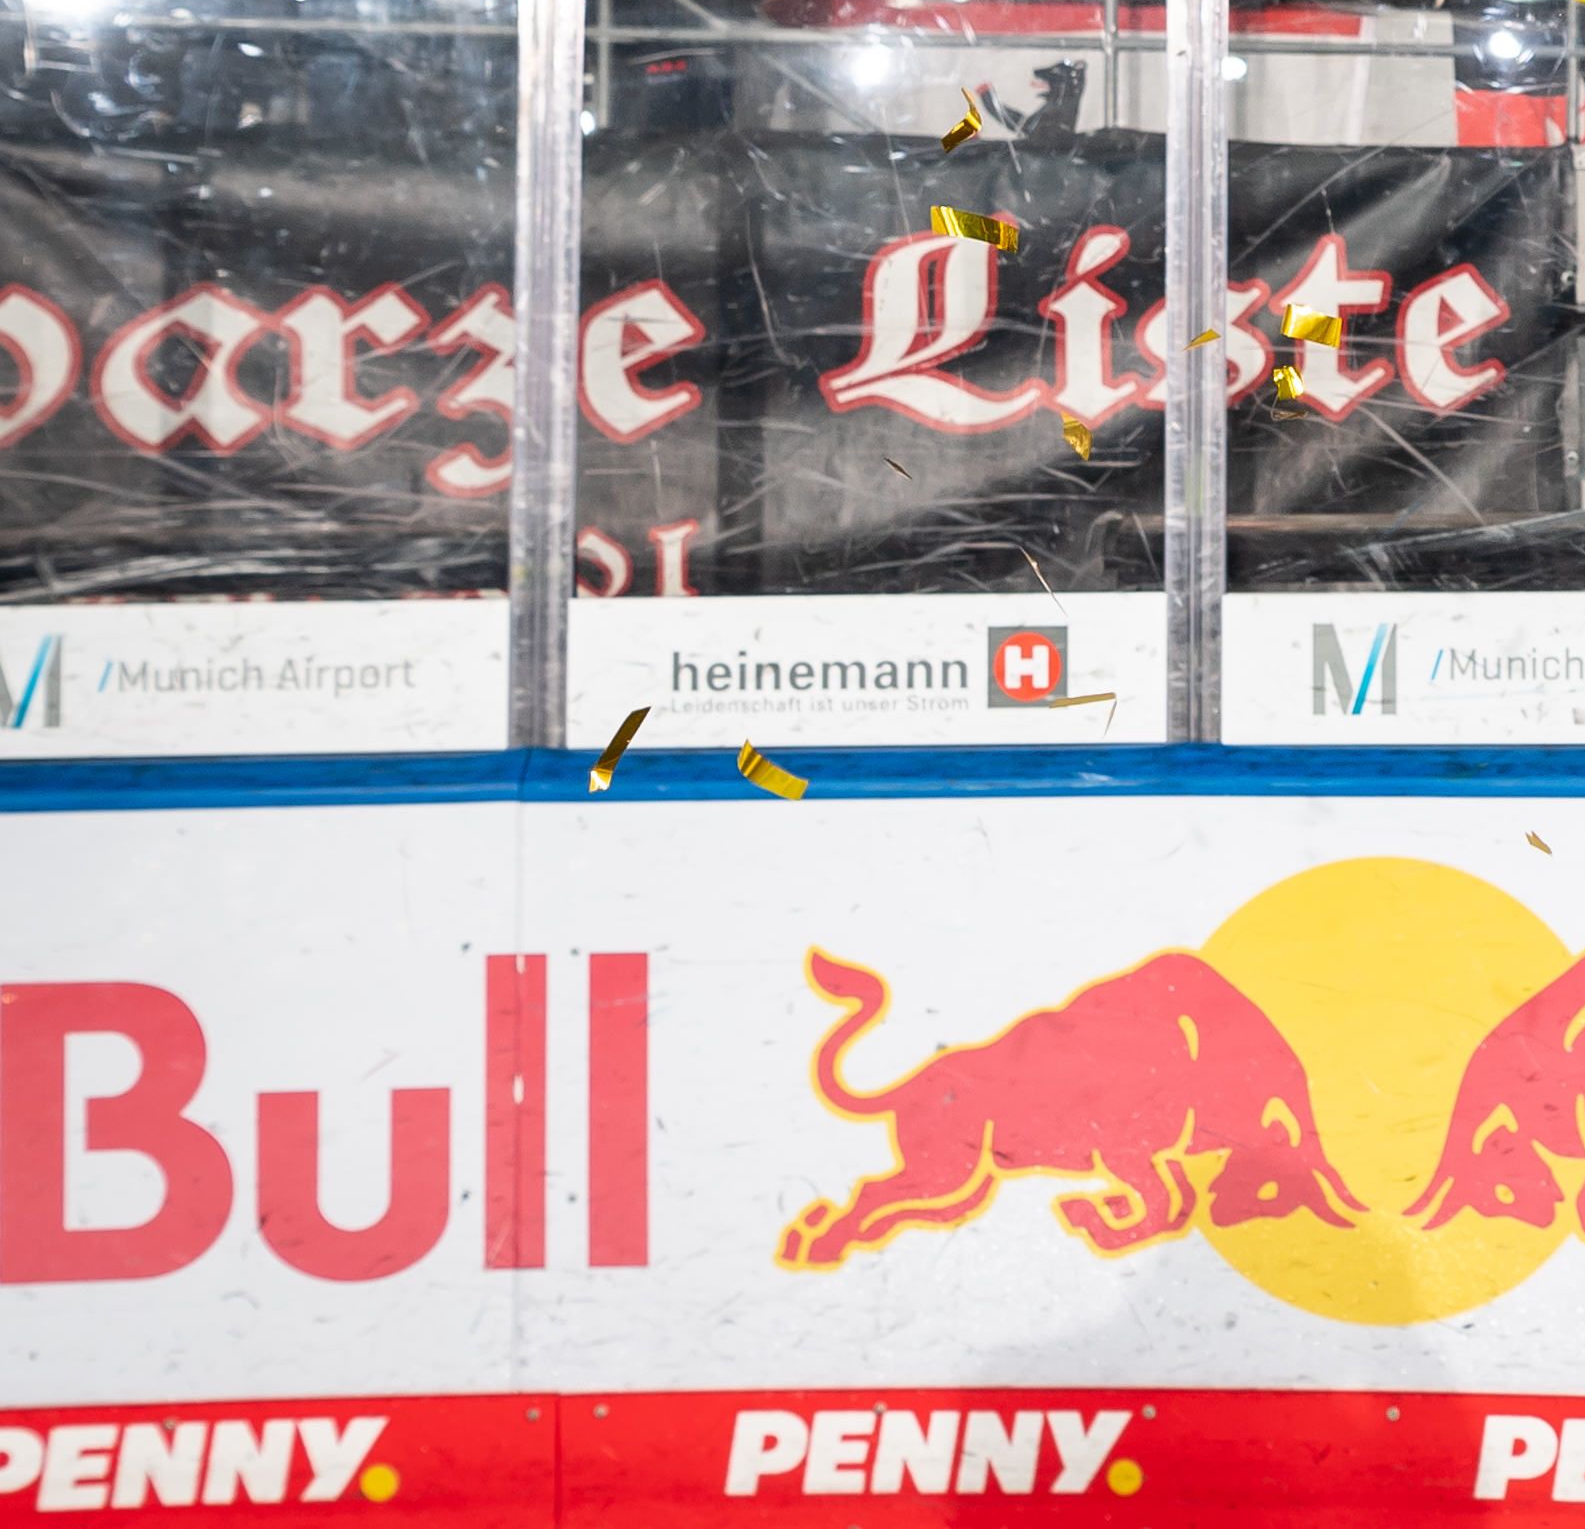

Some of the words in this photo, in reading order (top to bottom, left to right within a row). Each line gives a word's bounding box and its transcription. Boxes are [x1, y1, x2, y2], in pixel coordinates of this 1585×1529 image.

[820, 222, 1511, 436] Liste
[277, 656, 417, 698] Airport
[672, 650, 969, 692] heinemann
[670, 696, 802, 716] Leidenschaft
[809, 697, 833, 713] ist
[842, 697, 899, 713] unser
[906, 695, 970, 713] Strom
[0, 951, 650, 1285] Bull
[723, 1409, 1144, 1498] PENNY.
